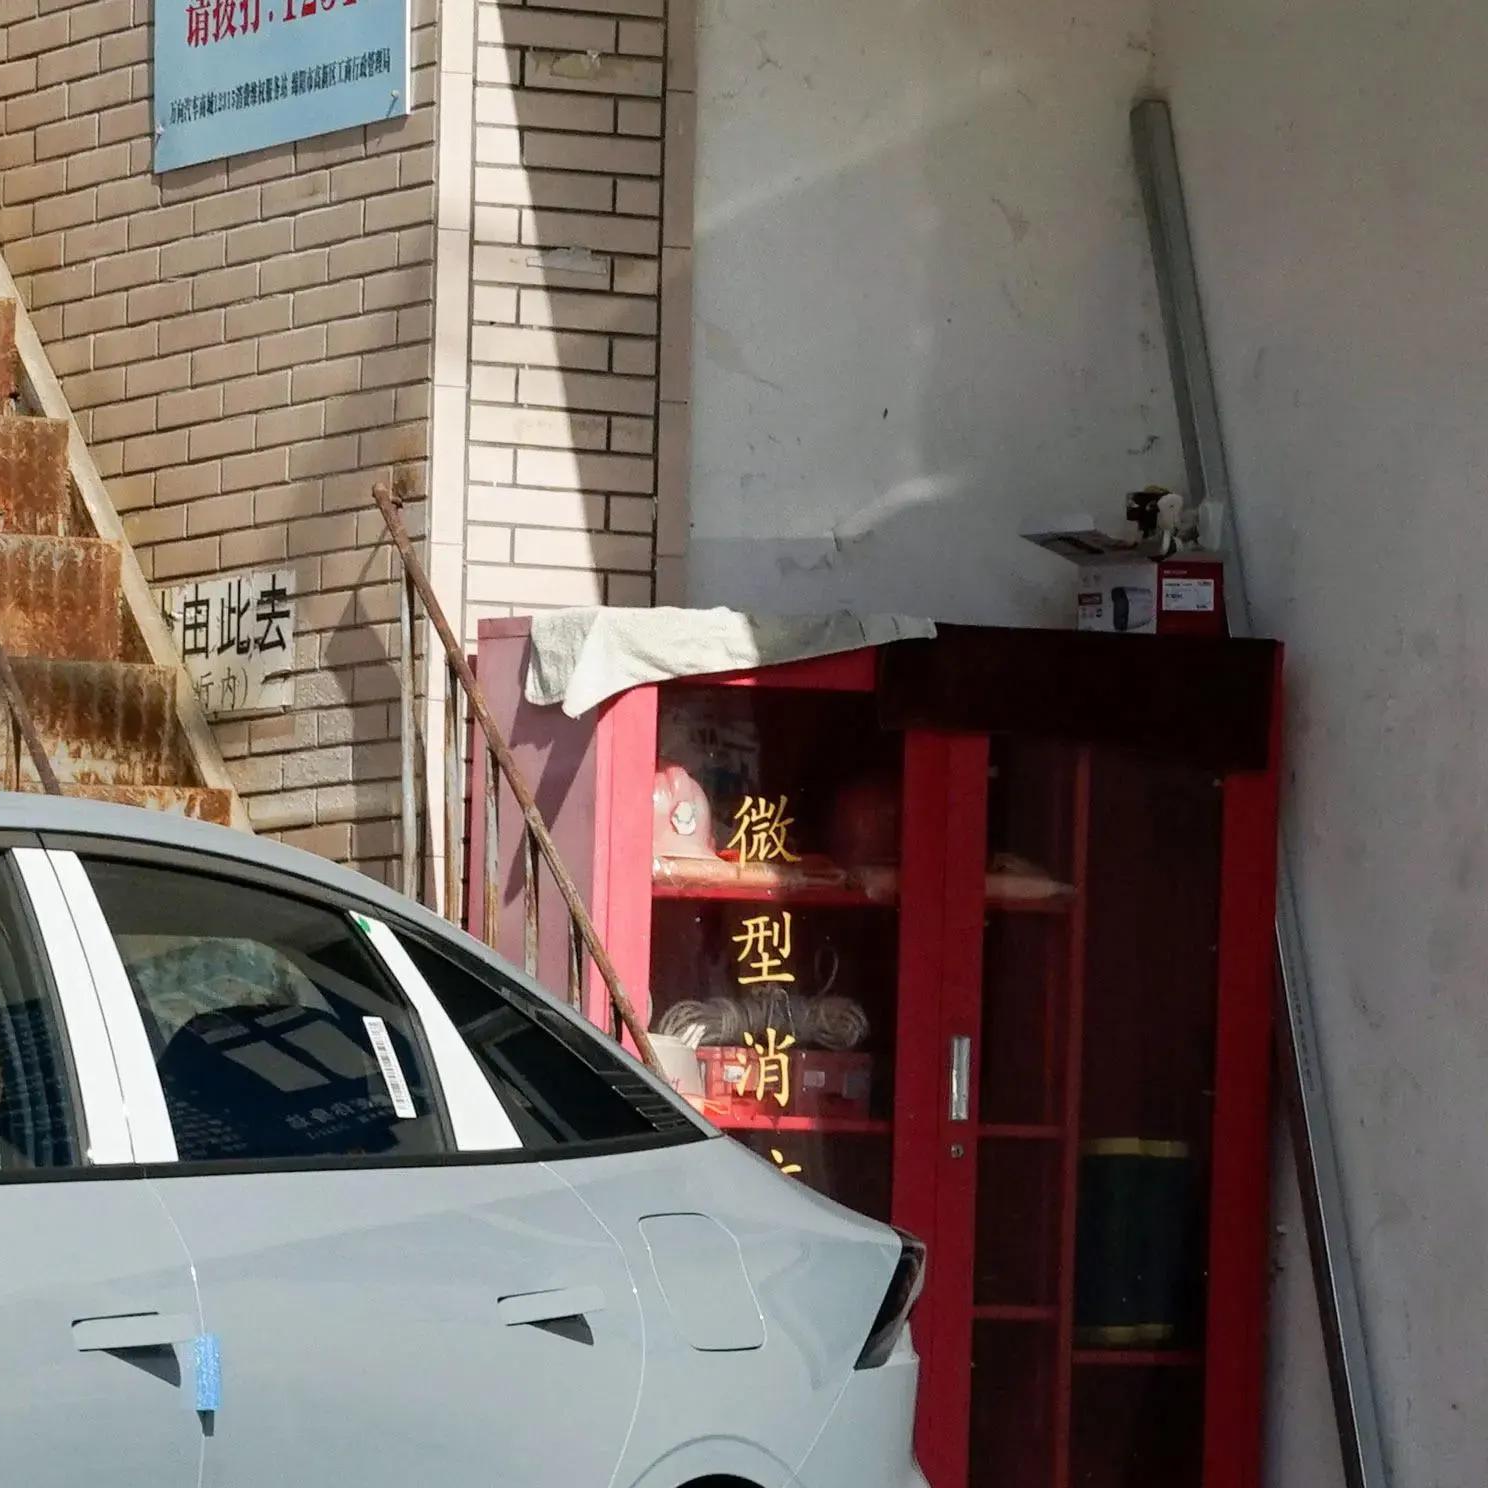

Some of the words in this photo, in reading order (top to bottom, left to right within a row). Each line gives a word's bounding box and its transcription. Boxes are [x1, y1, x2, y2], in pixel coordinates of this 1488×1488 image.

[161, 573, 291, 663] 由此去
[727, 795, 802, 1174] 微型消
